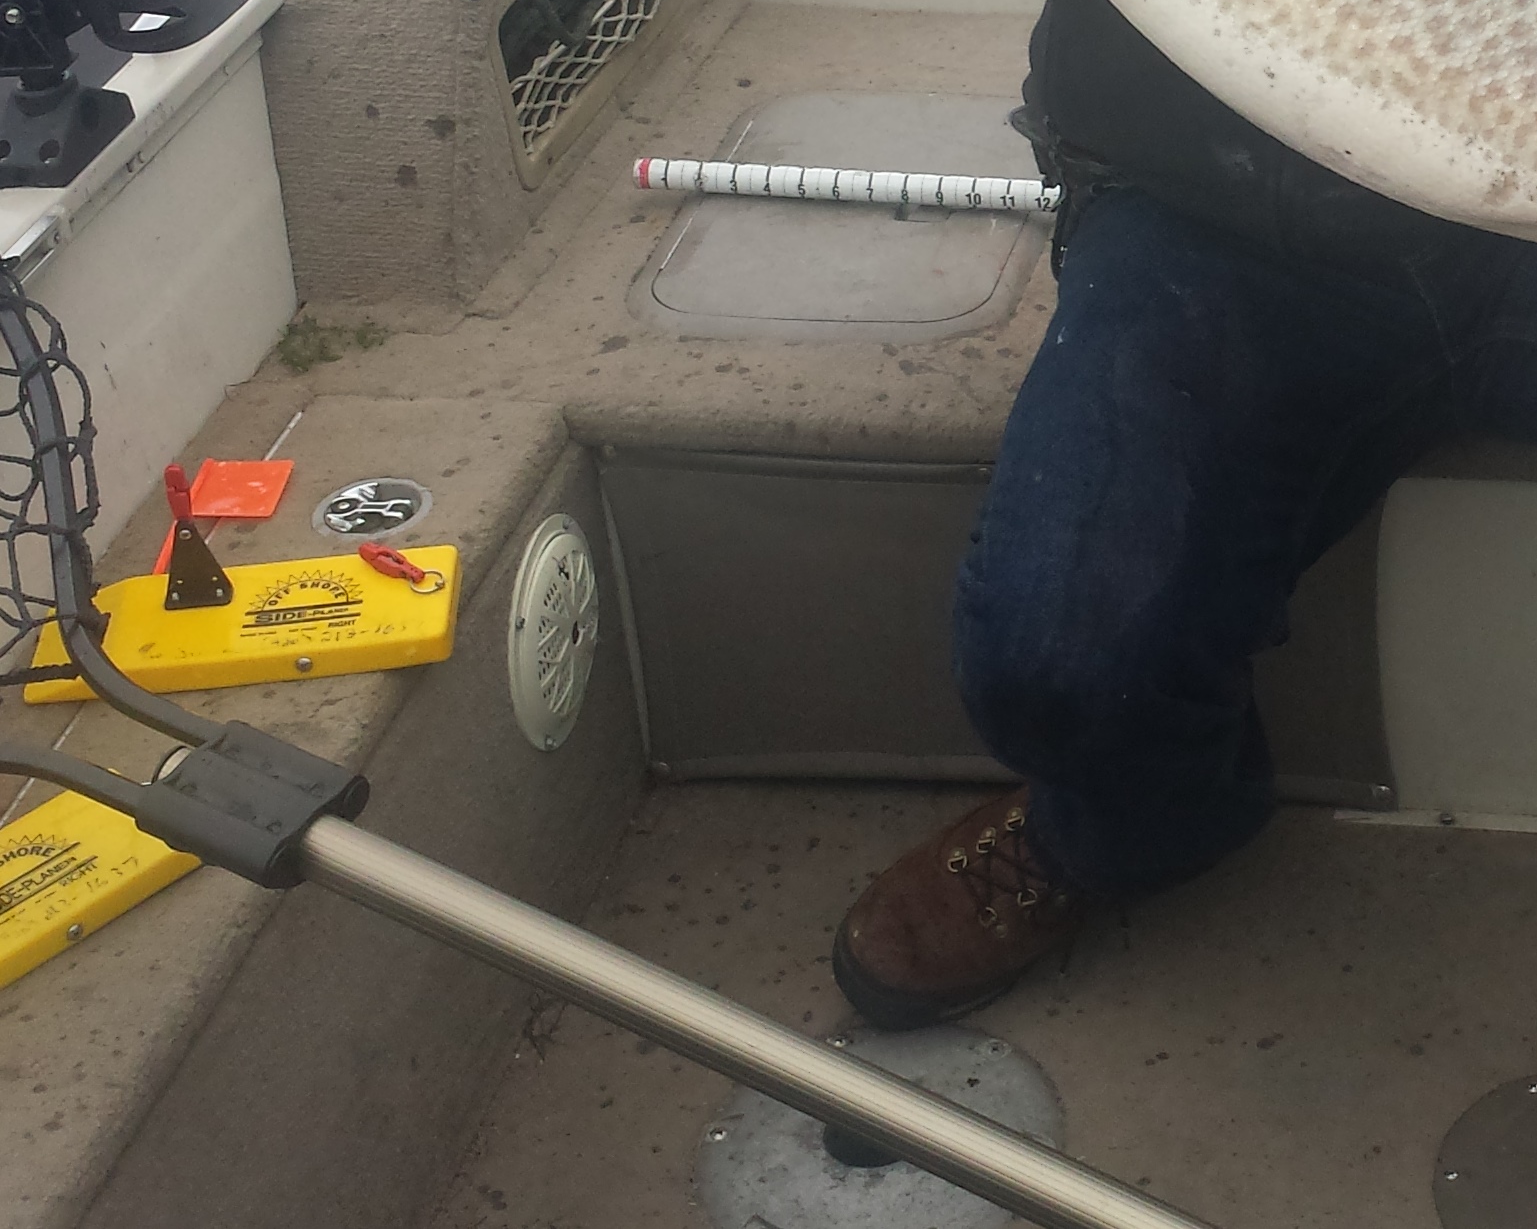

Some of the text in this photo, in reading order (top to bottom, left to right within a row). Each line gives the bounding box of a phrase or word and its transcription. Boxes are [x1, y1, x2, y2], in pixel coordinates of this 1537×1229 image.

[730, 179, 738, 191] 3
[763, 182, 771, 193] 4
[798, 184, 806, 196] 5
[832, 185, 840, 197] 6
[866, 188, 873, 199] 7
[902, 190, 909, 202] 8
[936, 191, 943, 203] 9
[966, 193, 981, 205] 10
[1000, 196, 1015, 207] 11
[1035, 197, 1051, 210] 12
[268, 580, 346, 607] OFF SHORE
